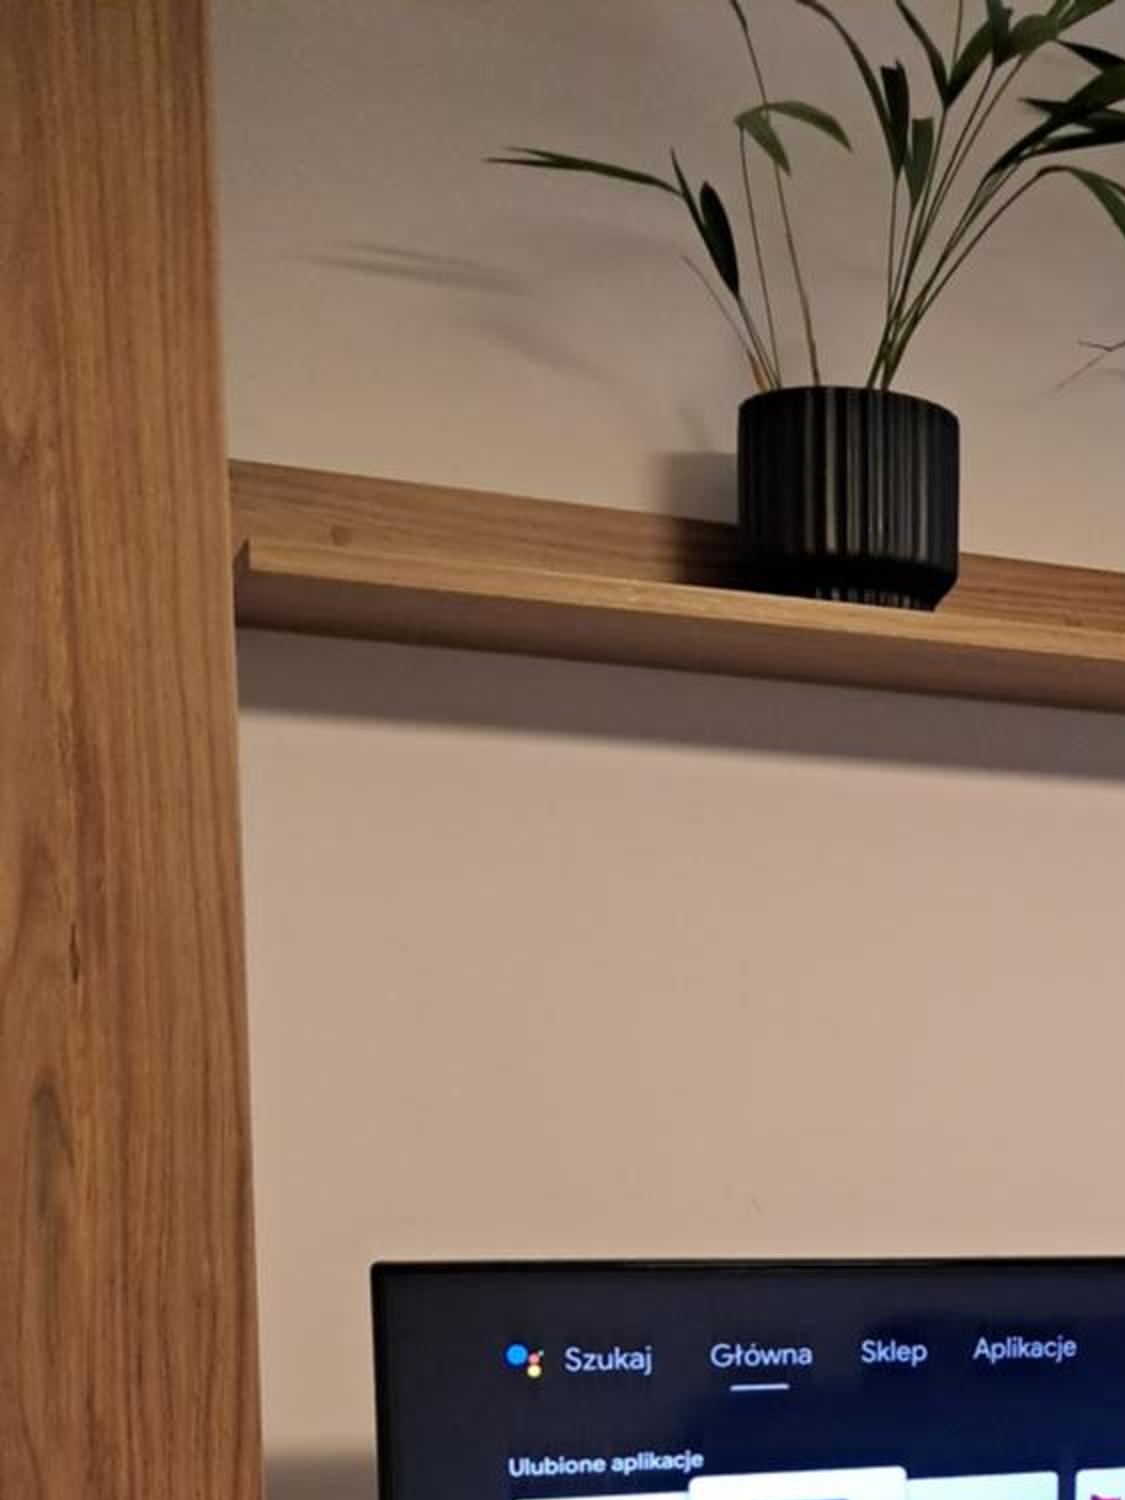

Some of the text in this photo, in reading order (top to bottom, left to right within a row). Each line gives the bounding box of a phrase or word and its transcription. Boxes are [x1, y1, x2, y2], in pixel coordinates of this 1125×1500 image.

[565, 1345, 653, 1376] Szukaj
[710, 1342, 813, 1368] Główna
[861, 1340, 927, 1368] Sklep
[972, 1335, 1077, 1363] Aplikacje
[509, 1450, 703, 1477] Ulubione aplikacje
